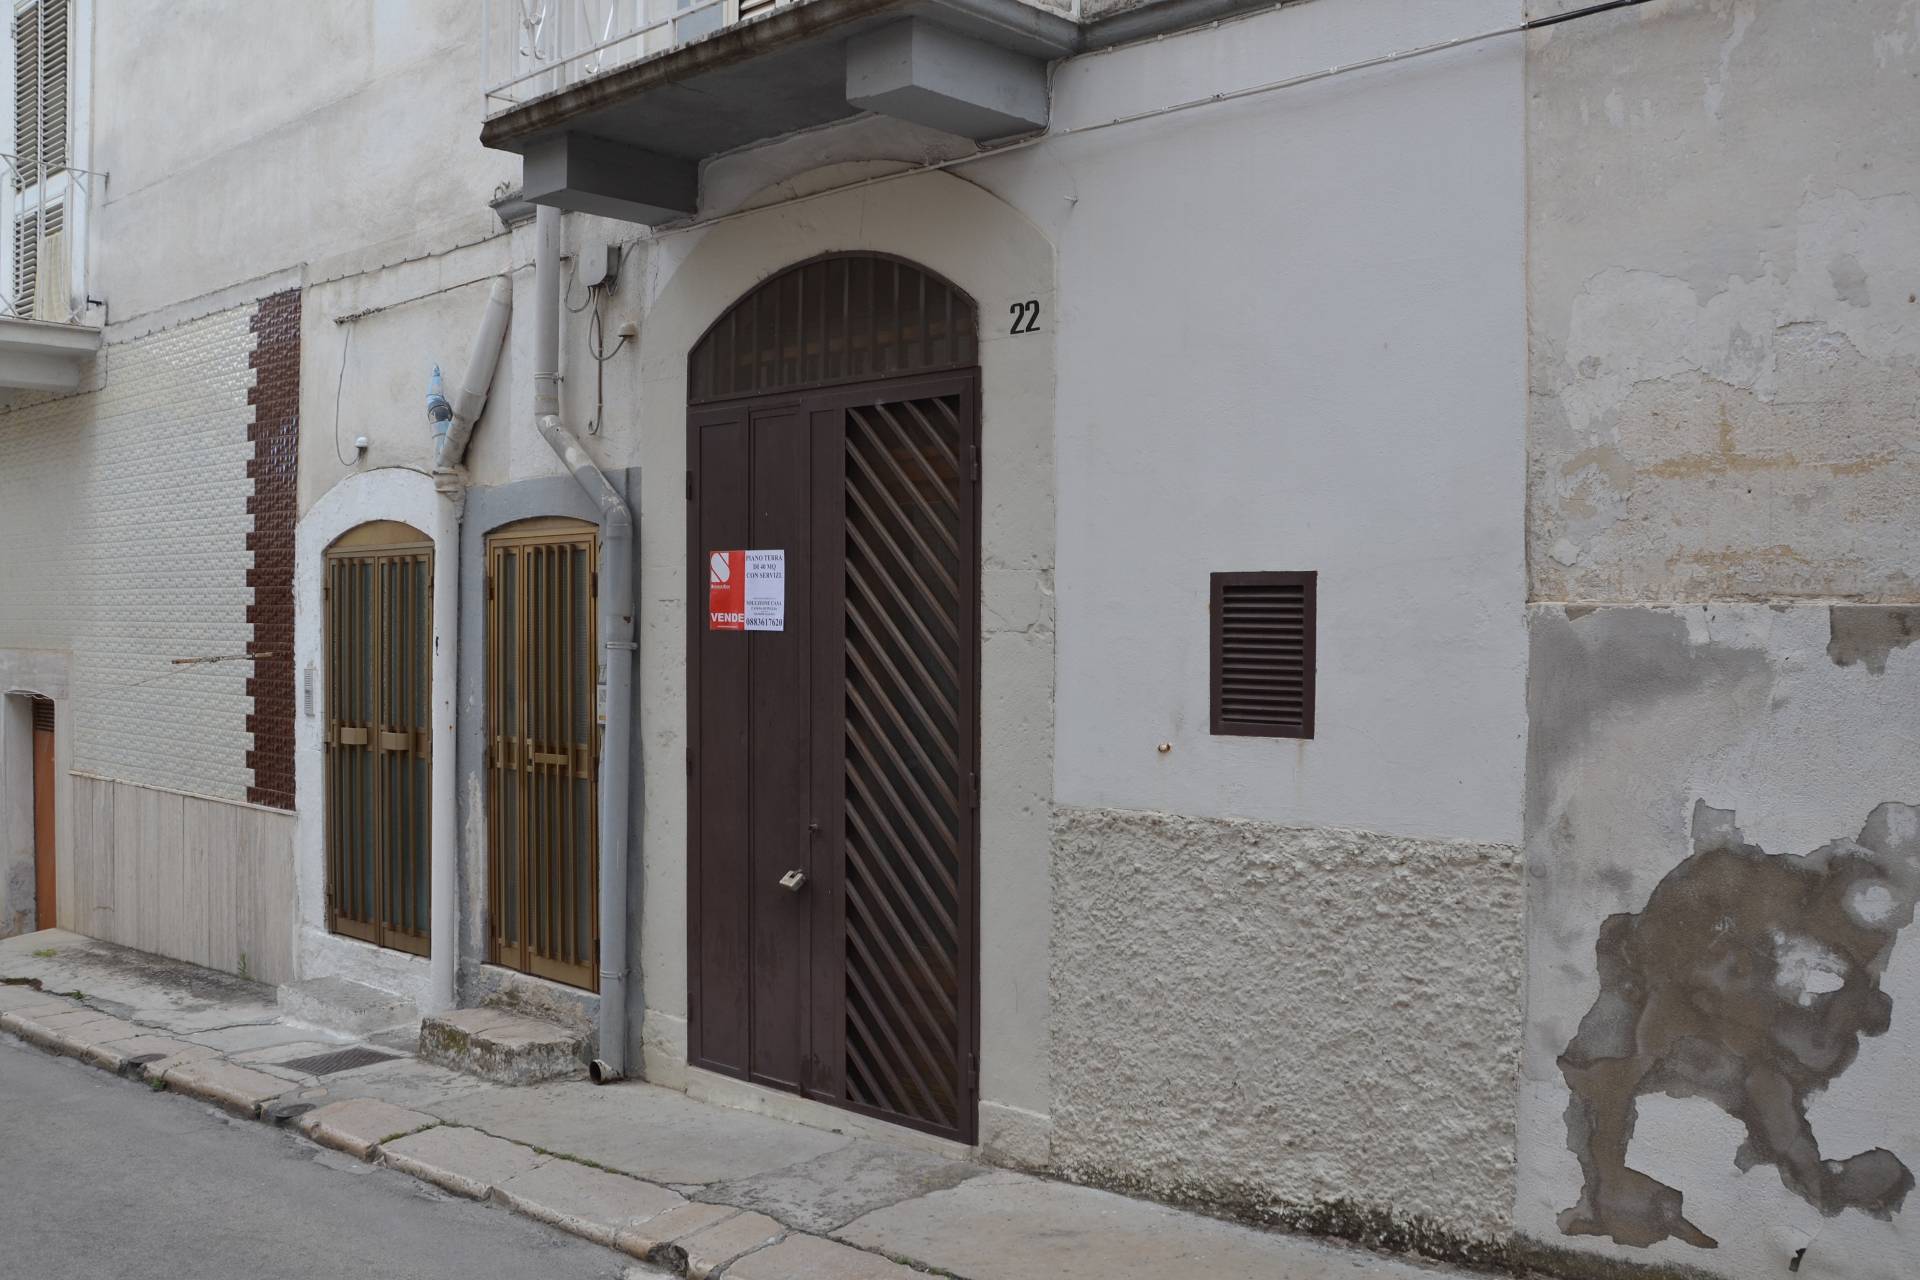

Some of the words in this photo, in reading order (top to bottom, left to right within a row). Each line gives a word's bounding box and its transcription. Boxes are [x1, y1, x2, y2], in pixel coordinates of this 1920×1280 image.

[1010, 300, 1040, 334] 22
[710, 612, 745, 623] VENDE
[746, 617, 783, 627] 0883617620
